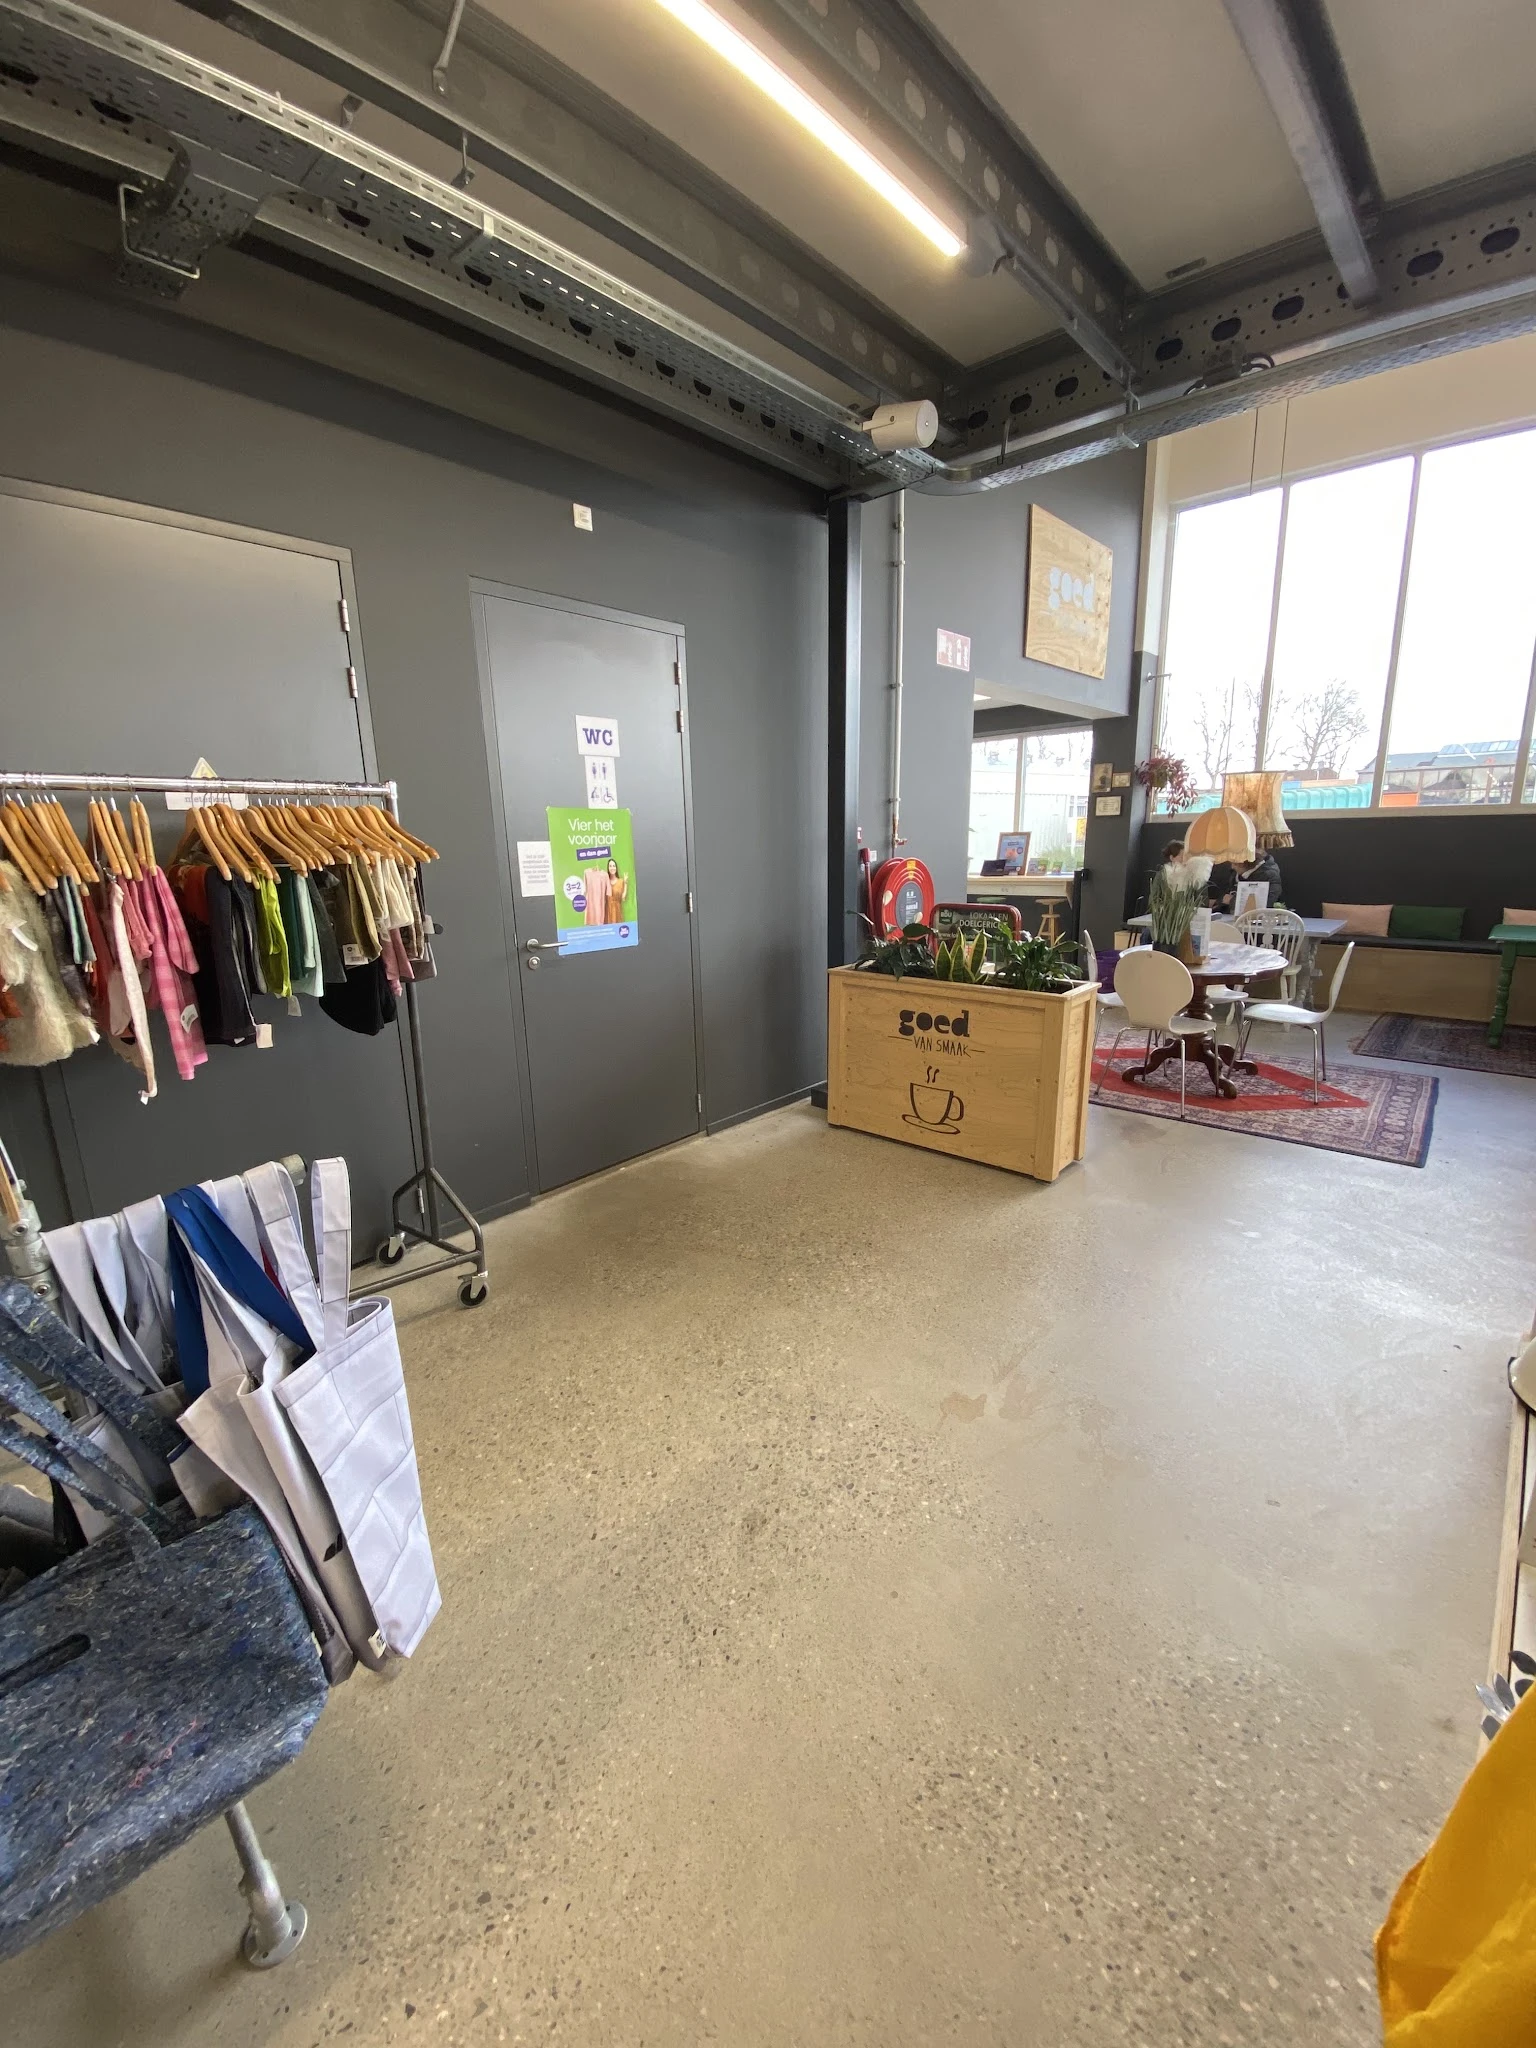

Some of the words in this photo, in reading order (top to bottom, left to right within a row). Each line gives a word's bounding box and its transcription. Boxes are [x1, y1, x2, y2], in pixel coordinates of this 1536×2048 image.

[1048, 566, 1095, 613] goed
[582, 727, 613, 746] WC
[568, 818, 592, 831] Vier
[594, 818, 614, 831] het
[568, 832, 617, 848] voorjaar
[596, 848, 609, 857] goed
[566, 881, 581, 891] 3=2
[959, 919, 1008, 929] DOELGERIC
[898, 1009, 970, 1037] goed
[913, 1036, 932, 1052] VAN
[936, 1039, 971, 1058] SMAAK
